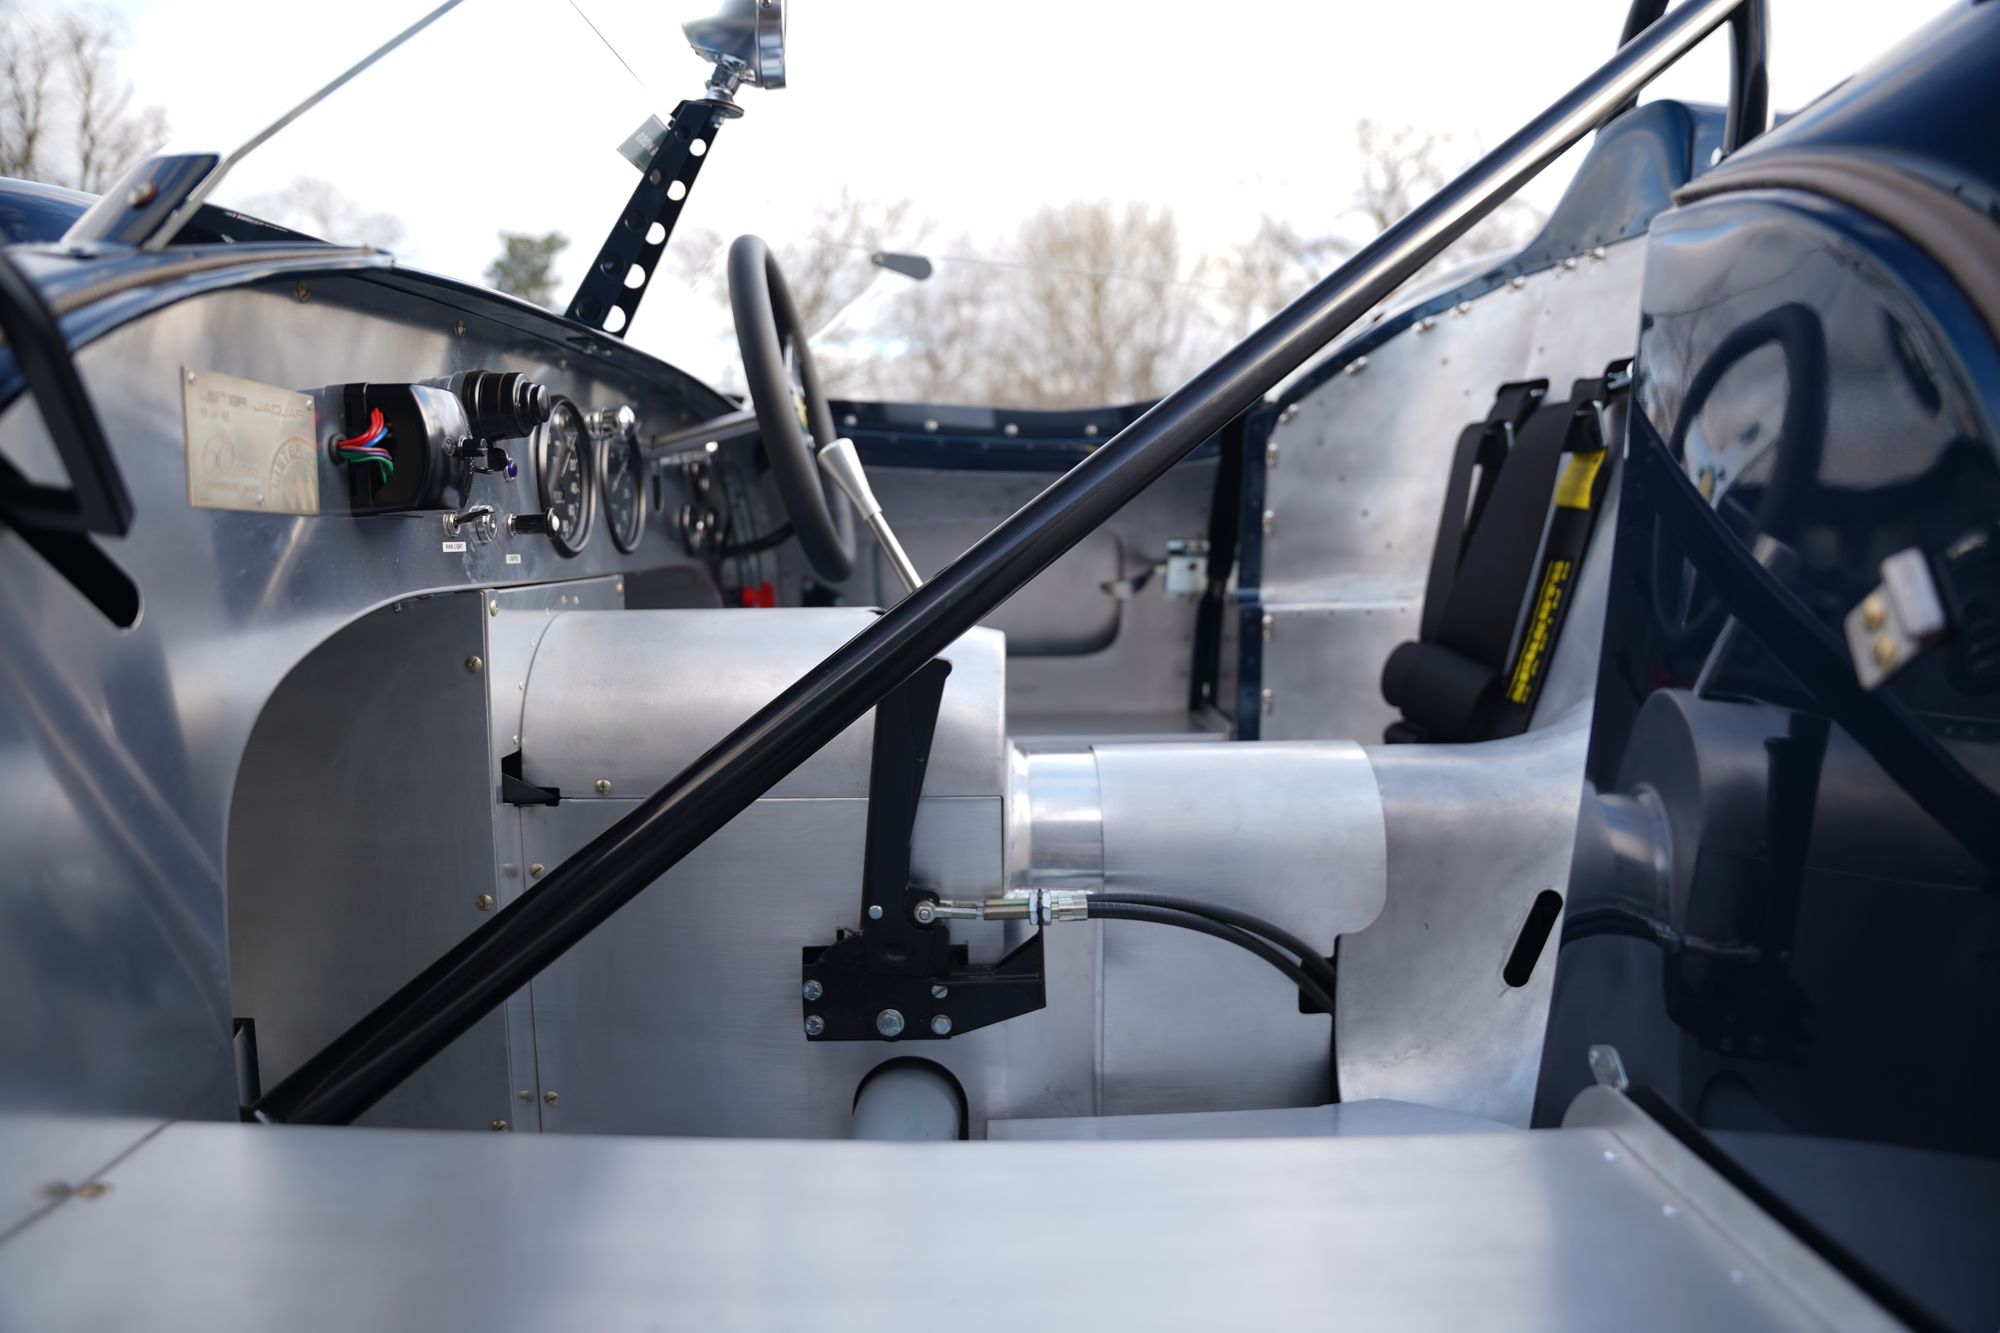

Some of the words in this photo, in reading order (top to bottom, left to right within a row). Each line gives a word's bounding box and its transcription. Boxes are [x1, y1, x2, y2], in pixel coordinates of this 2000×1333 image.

[200, 390, 248, 408] LISTER
[254, 400, 305, 418] JAGUAR
[272, 444, 304, 490] LISTER
